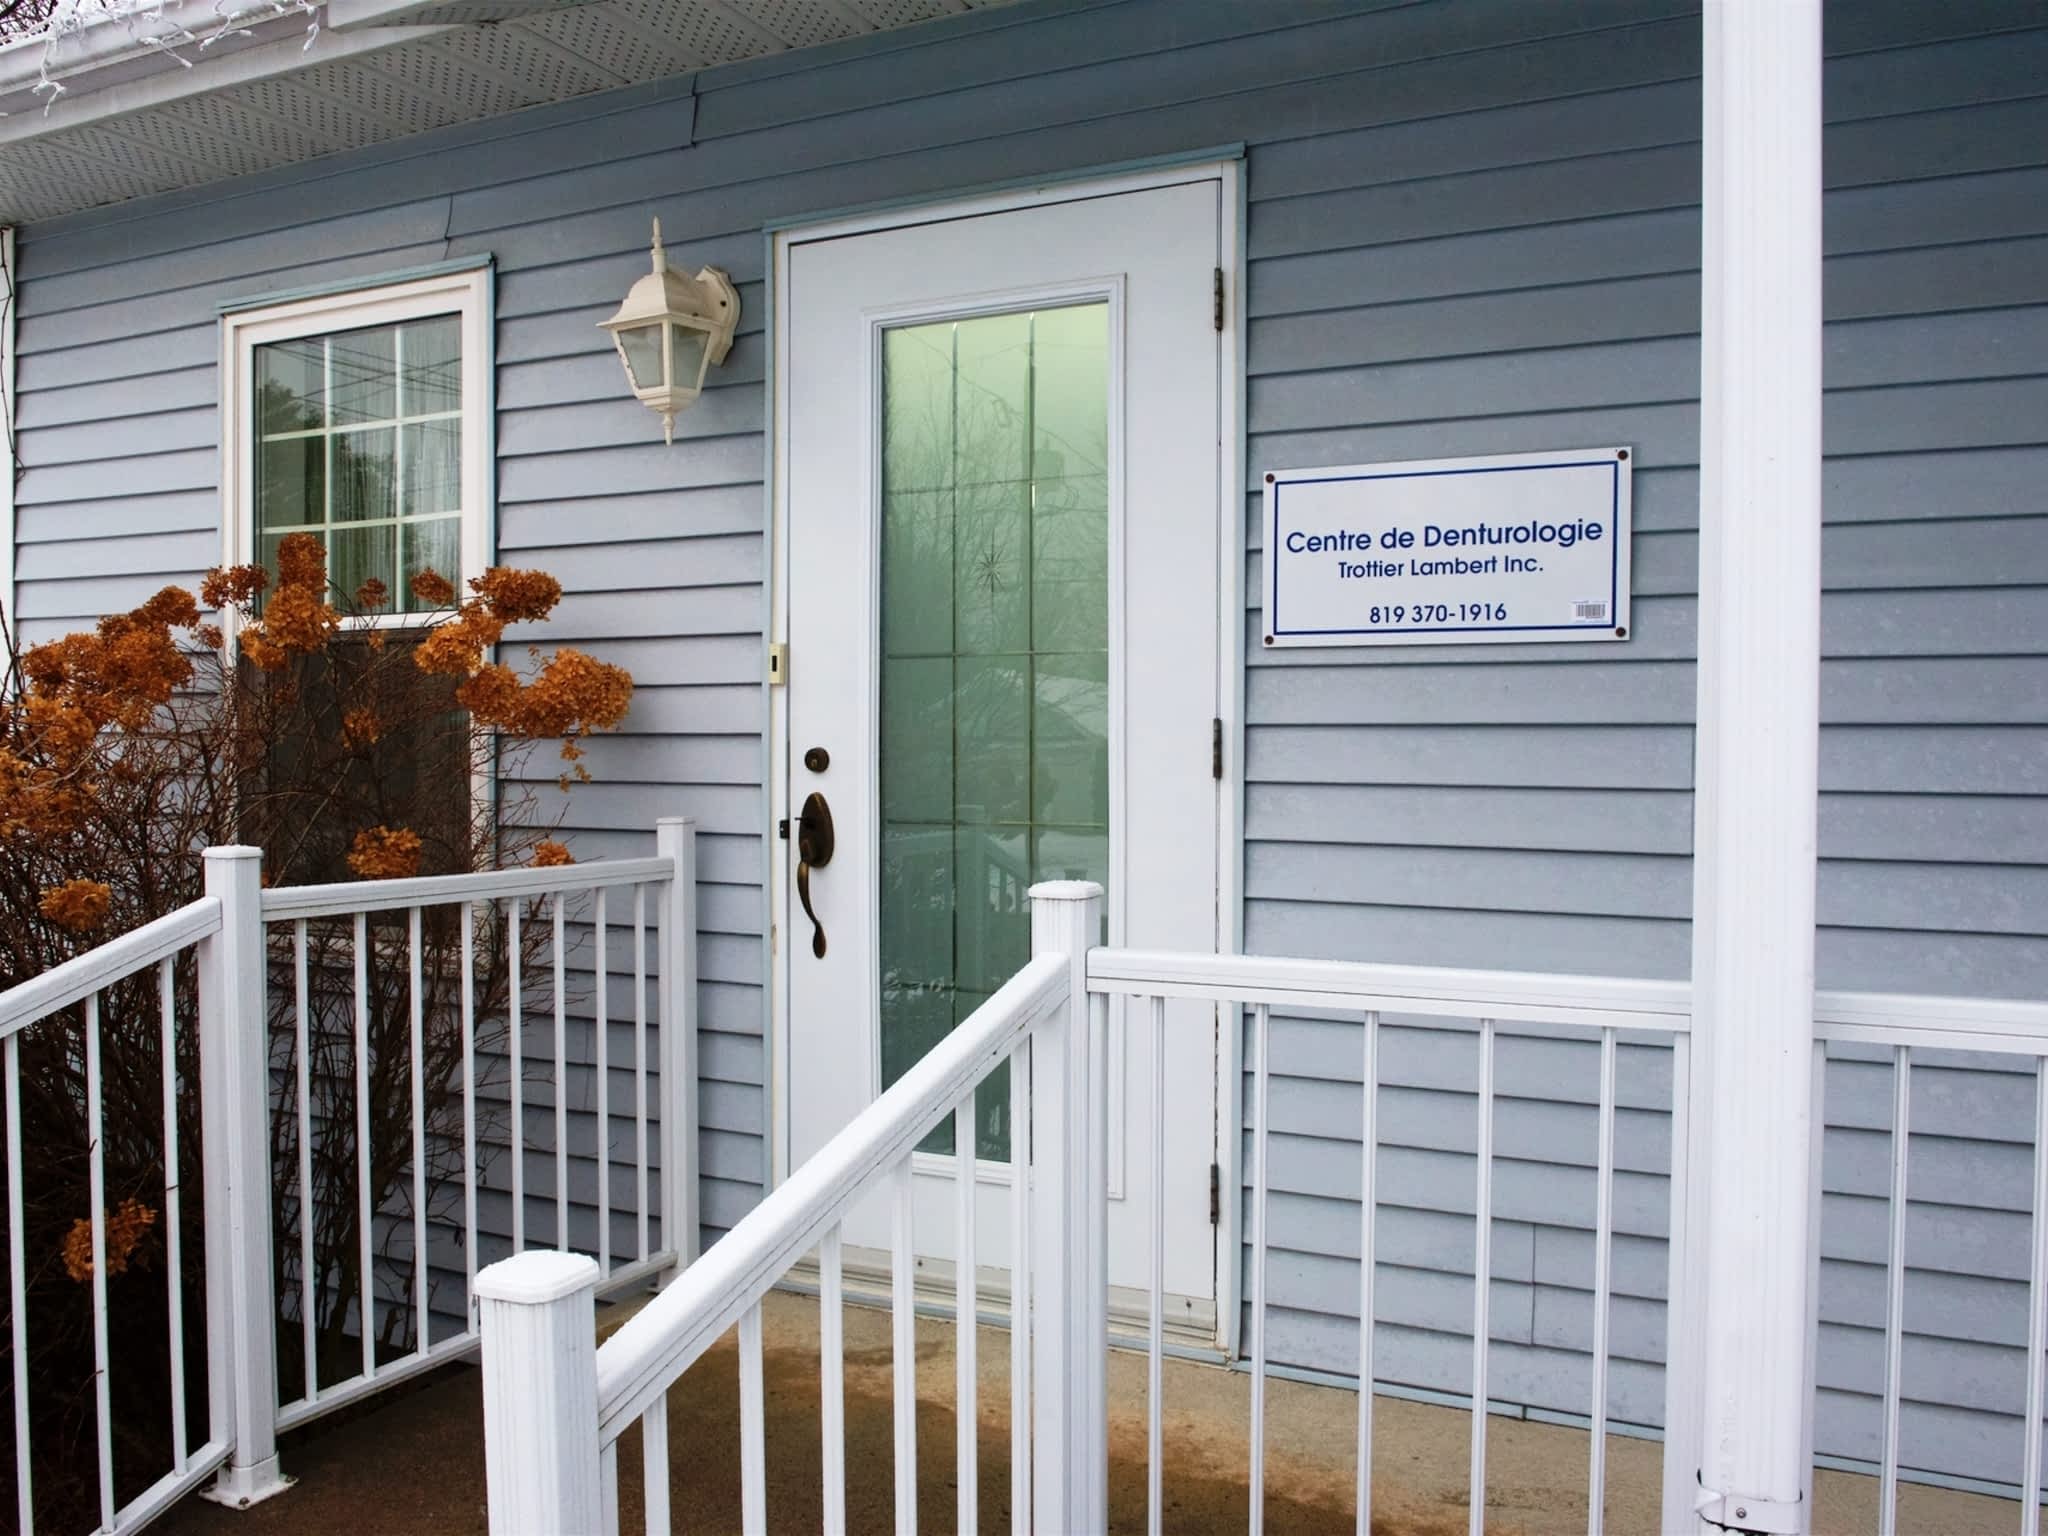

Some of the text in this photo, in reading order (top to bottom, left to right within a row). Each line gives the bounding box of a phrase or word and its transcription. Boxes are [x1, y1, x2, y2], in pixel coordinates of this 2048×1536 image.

[1285, 518, 1603, 553] Centre de Denturologie
[1338, 554, 1543, 578] Trottier Lambert Inc.
[1370, 603, 1506, 623] 819 370-1916
